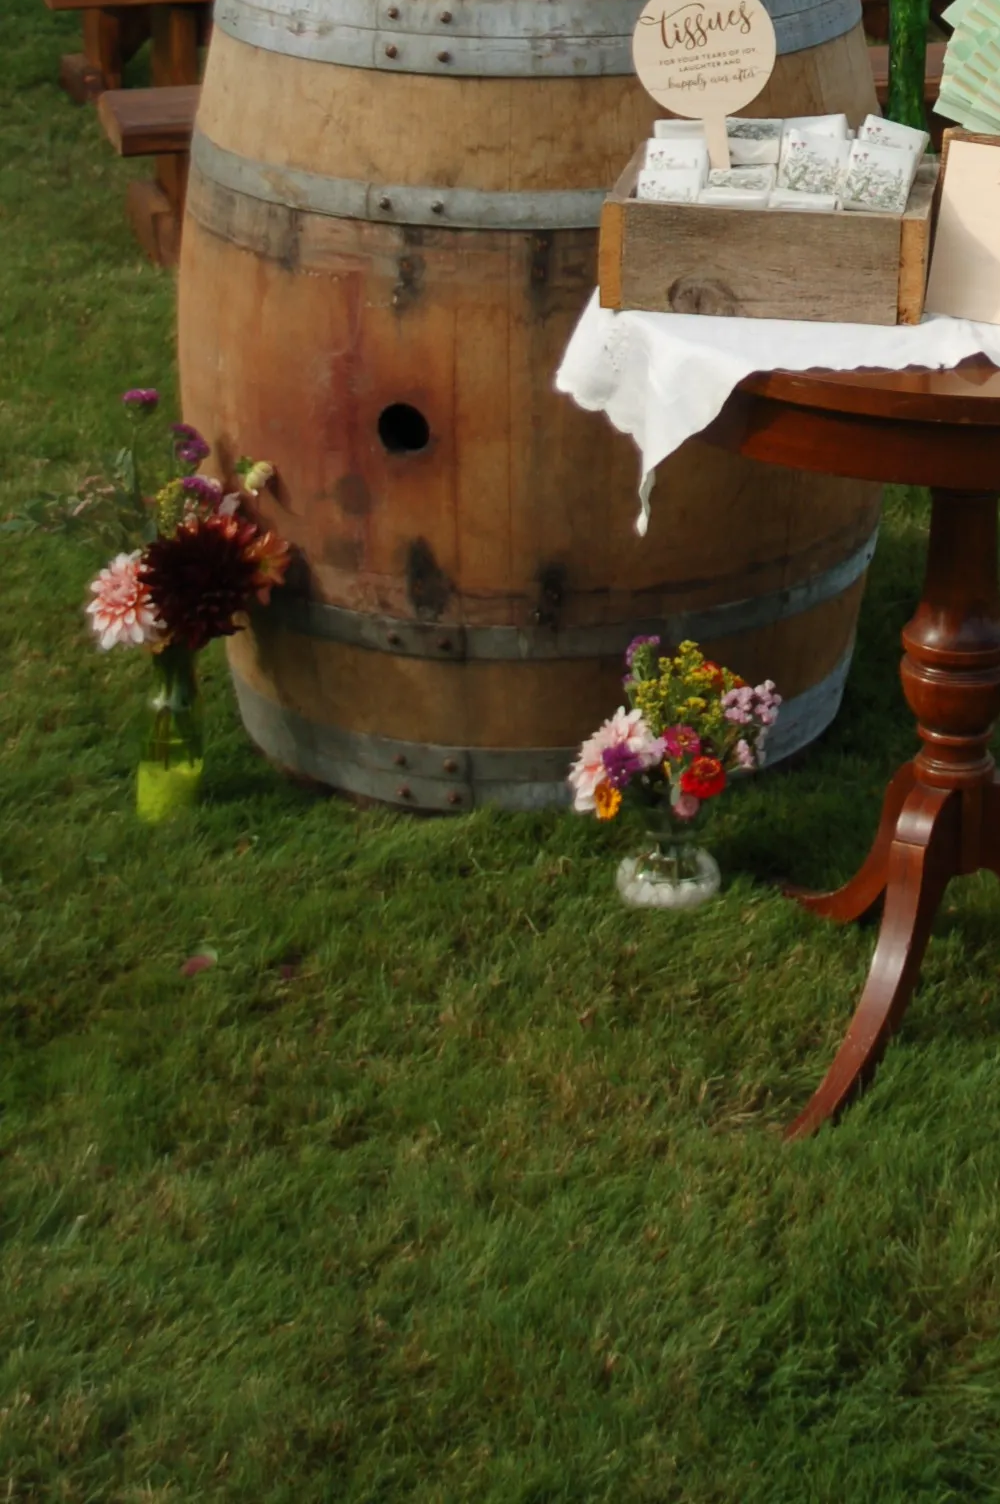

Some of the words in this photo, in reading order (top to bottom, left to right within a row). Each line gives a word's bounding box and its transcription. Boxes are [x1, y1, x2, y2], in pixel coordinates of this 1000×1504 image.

[678, 56, 700, 64] YOUR
[702, 51, 727, 59] TEARS
[729, 49, 740, 57] OF
[679, 61, 721, 73] LAUGHTER
[723, 58, 741, 66] AND
[667, 73, 708, 91] happily
